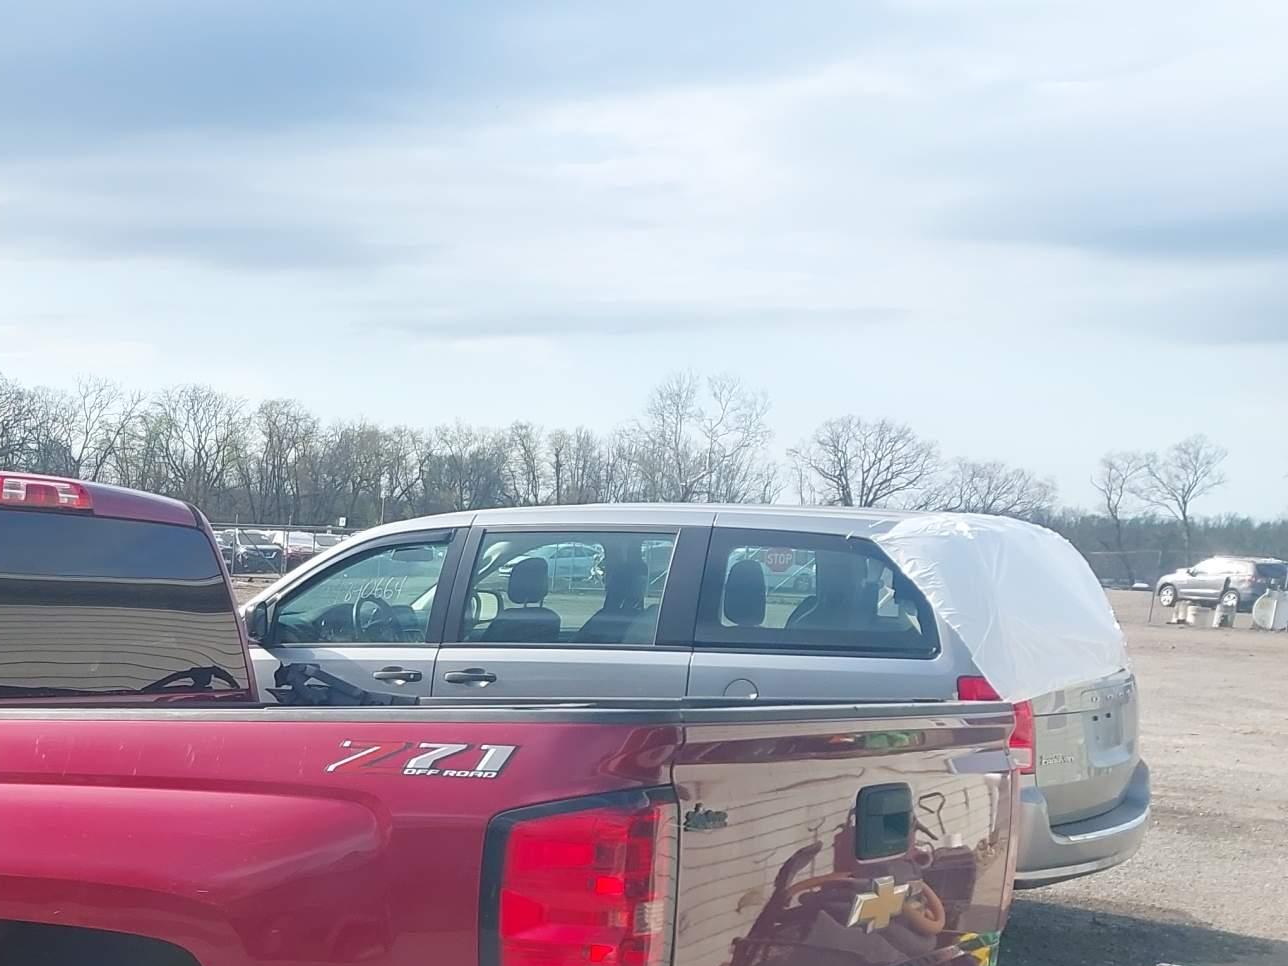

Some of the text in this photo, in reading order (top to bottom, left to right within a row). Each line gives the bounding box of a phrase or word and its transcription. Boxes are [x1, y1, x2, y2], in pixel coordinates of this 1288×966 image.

[767, 553, 793, 565] STOP
[403, 767, 498, 780] OFF ROAD
